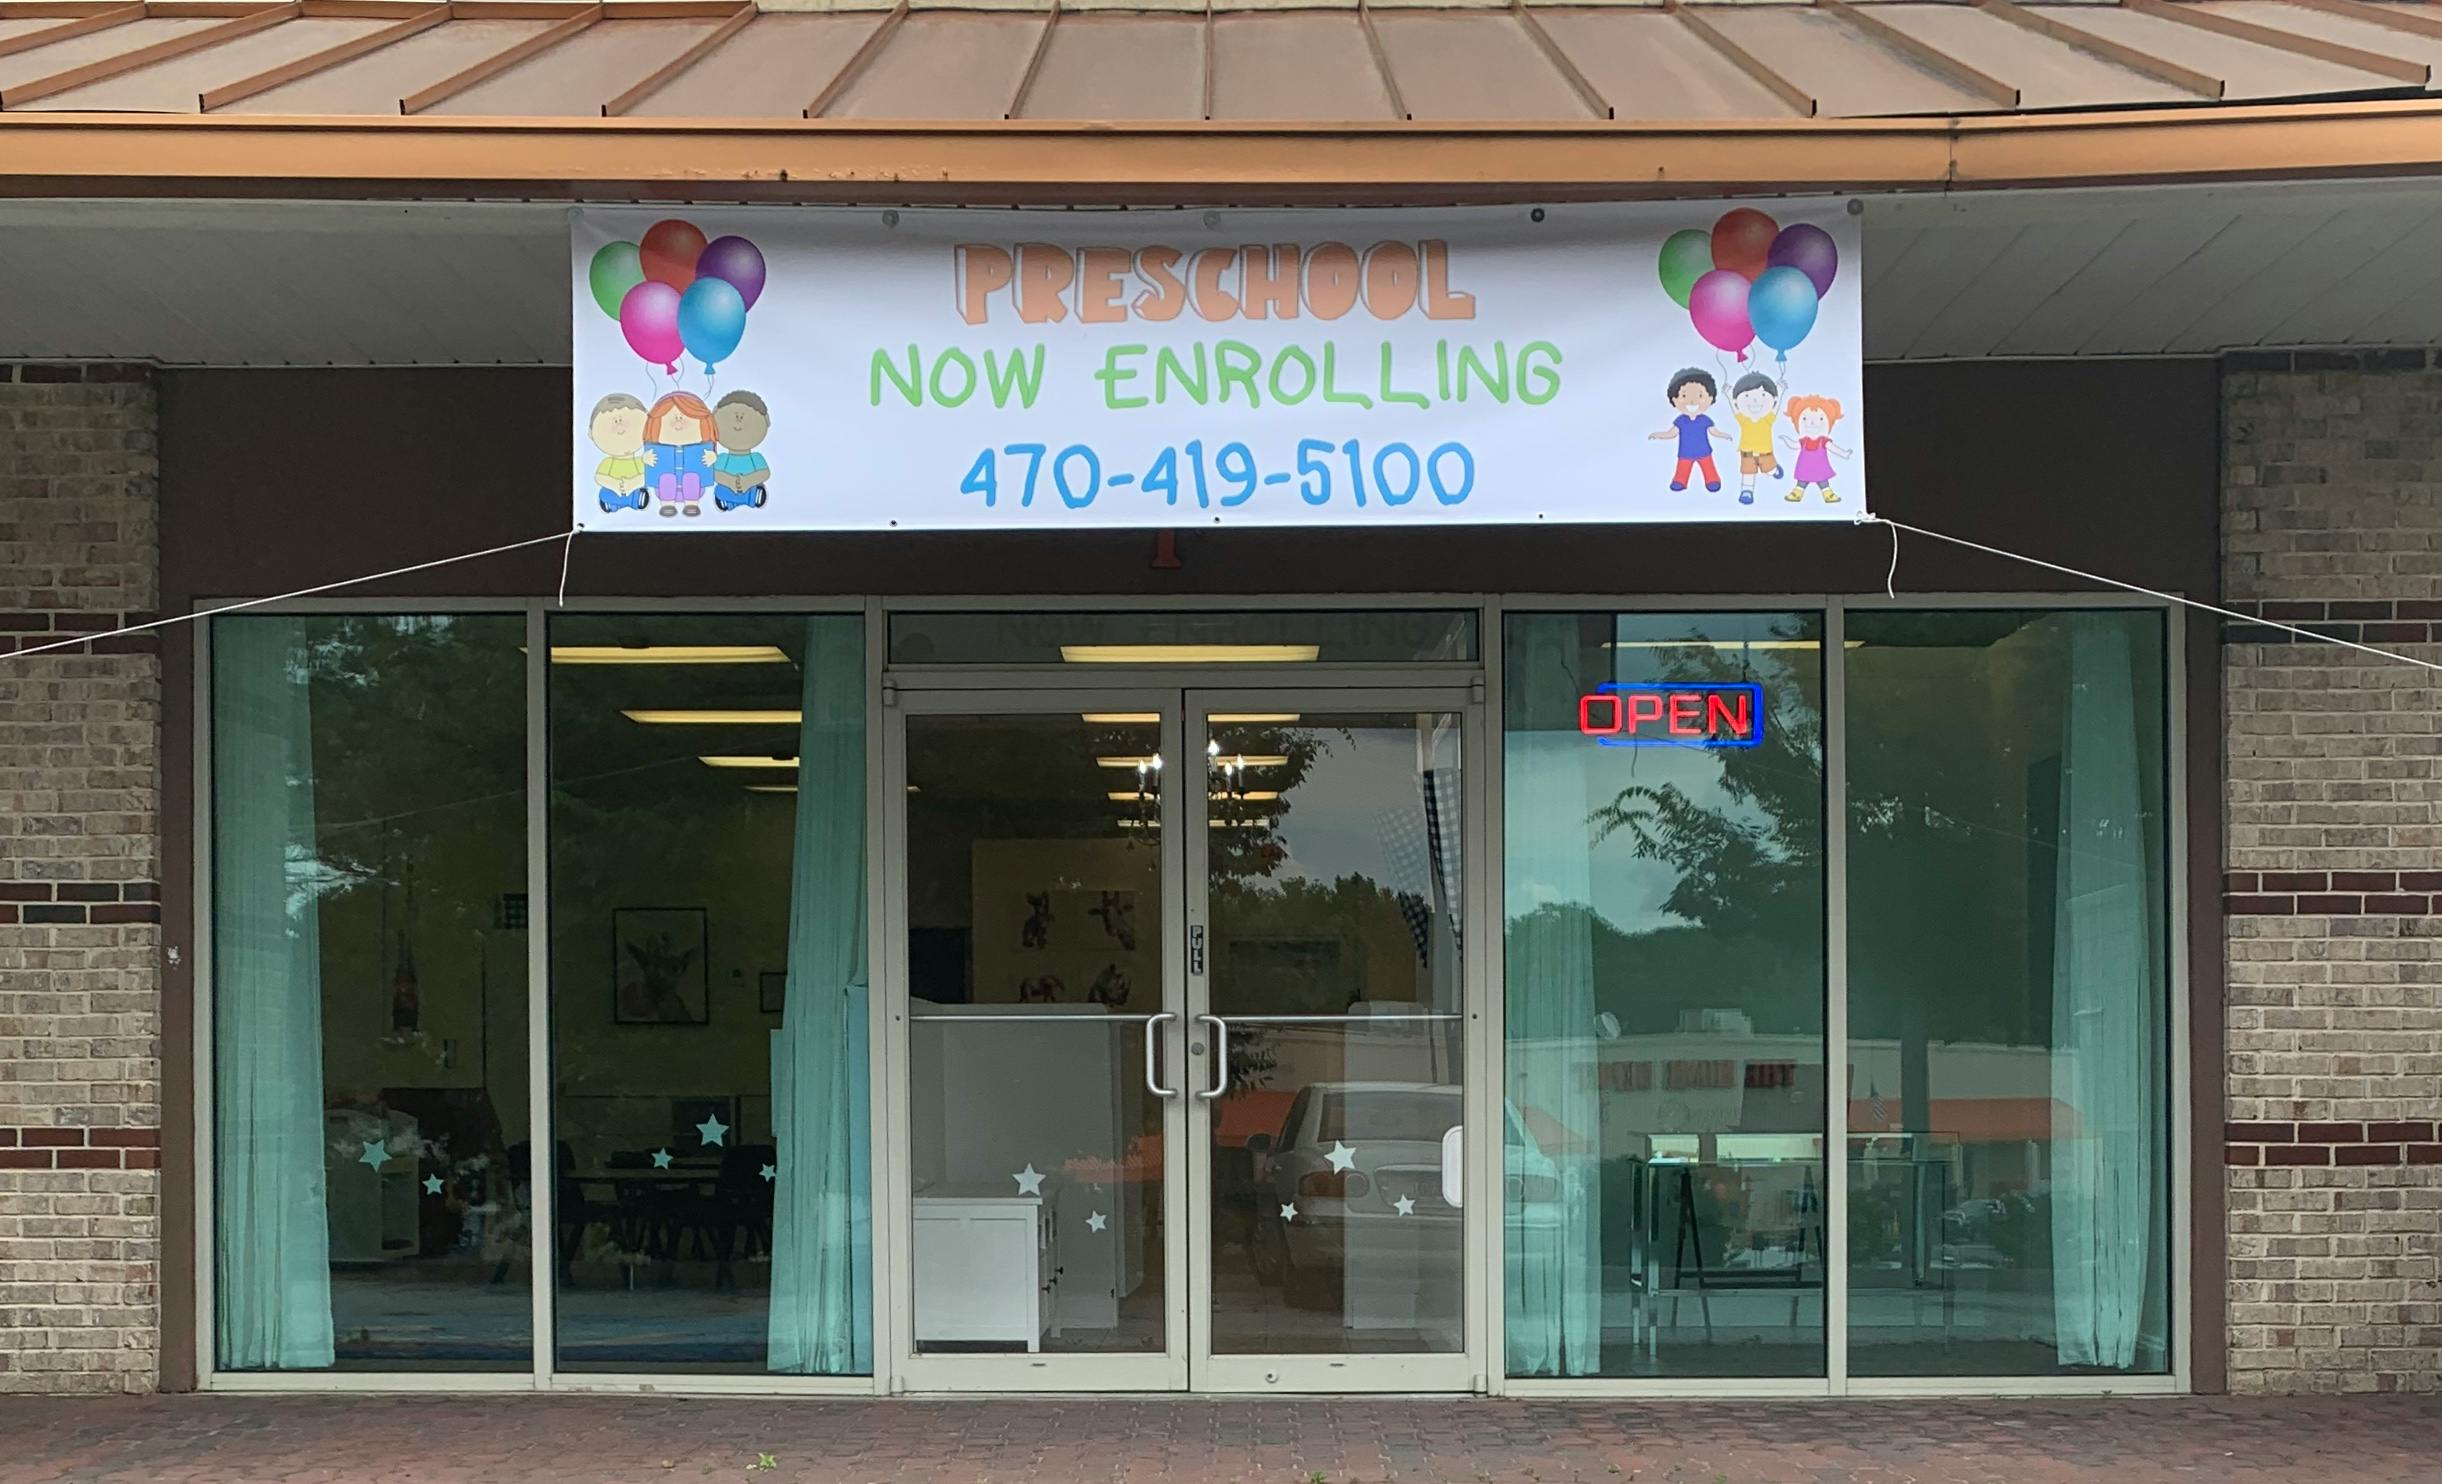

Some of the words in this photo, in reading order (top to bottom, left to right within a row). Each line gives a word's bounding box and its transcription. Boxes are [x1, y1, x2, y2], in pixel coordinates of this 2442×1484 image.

[954, 240, 1476, 324] PRESCHOOL
[870, 344, 1046, 410] NOW
[1095, 340, 1563, 410] ENROLLING
[960, 439, 1475, 509] 470-419-5100
[1578, 693, 1749, 736] OPEN
[1191, 926, 1203, 974] PULL
